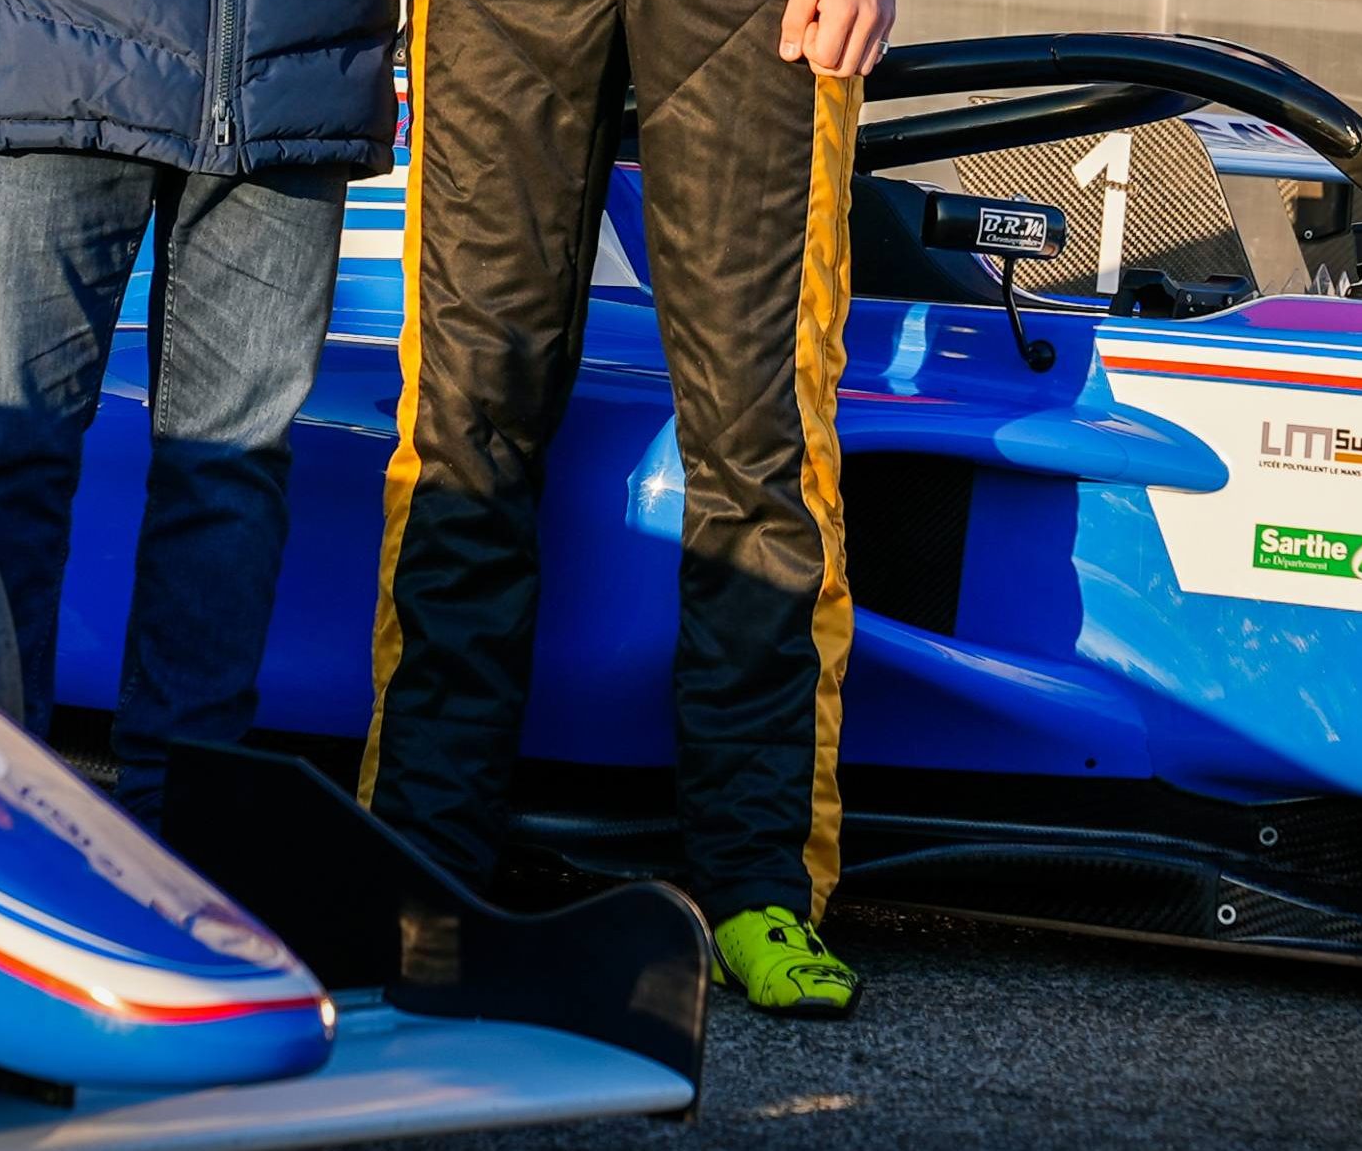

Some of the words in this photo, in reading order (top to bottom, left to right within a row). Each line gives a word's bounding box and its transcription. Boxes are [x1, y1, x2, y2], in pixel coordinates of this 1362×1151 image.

[1073, 132, 1132, 294] 1
[1259, 554, 1271, 564] Le
[1260, 528, 1348, 560] Sarthe
